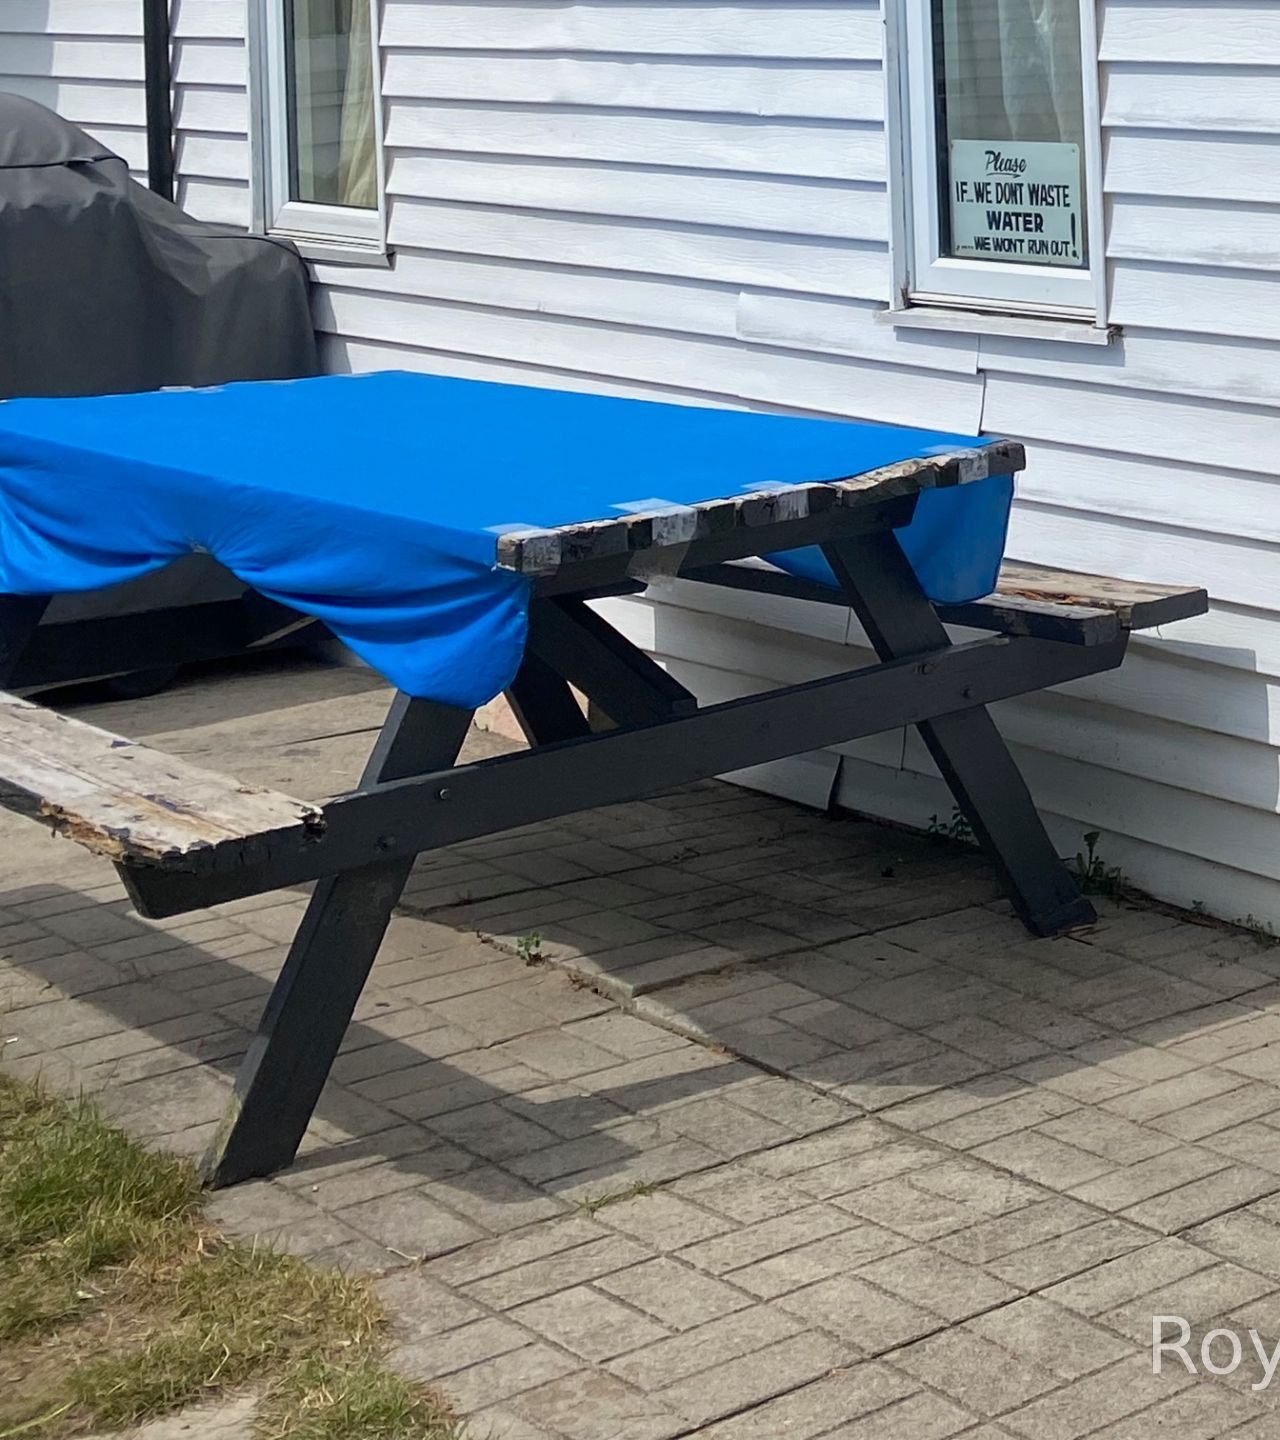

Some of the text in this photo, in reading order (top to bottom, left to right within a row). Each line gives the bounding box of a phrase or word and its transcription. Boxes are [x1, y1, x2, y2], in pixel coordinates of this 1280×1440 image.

[984, 150, 1028, 173] Please
[973, 181, 993, 204] WE
[1027, 182, 1071, 208] WASTE
[986, 210, 1044, 233] WATER
[1027, 239, 1049, 256] RUN
